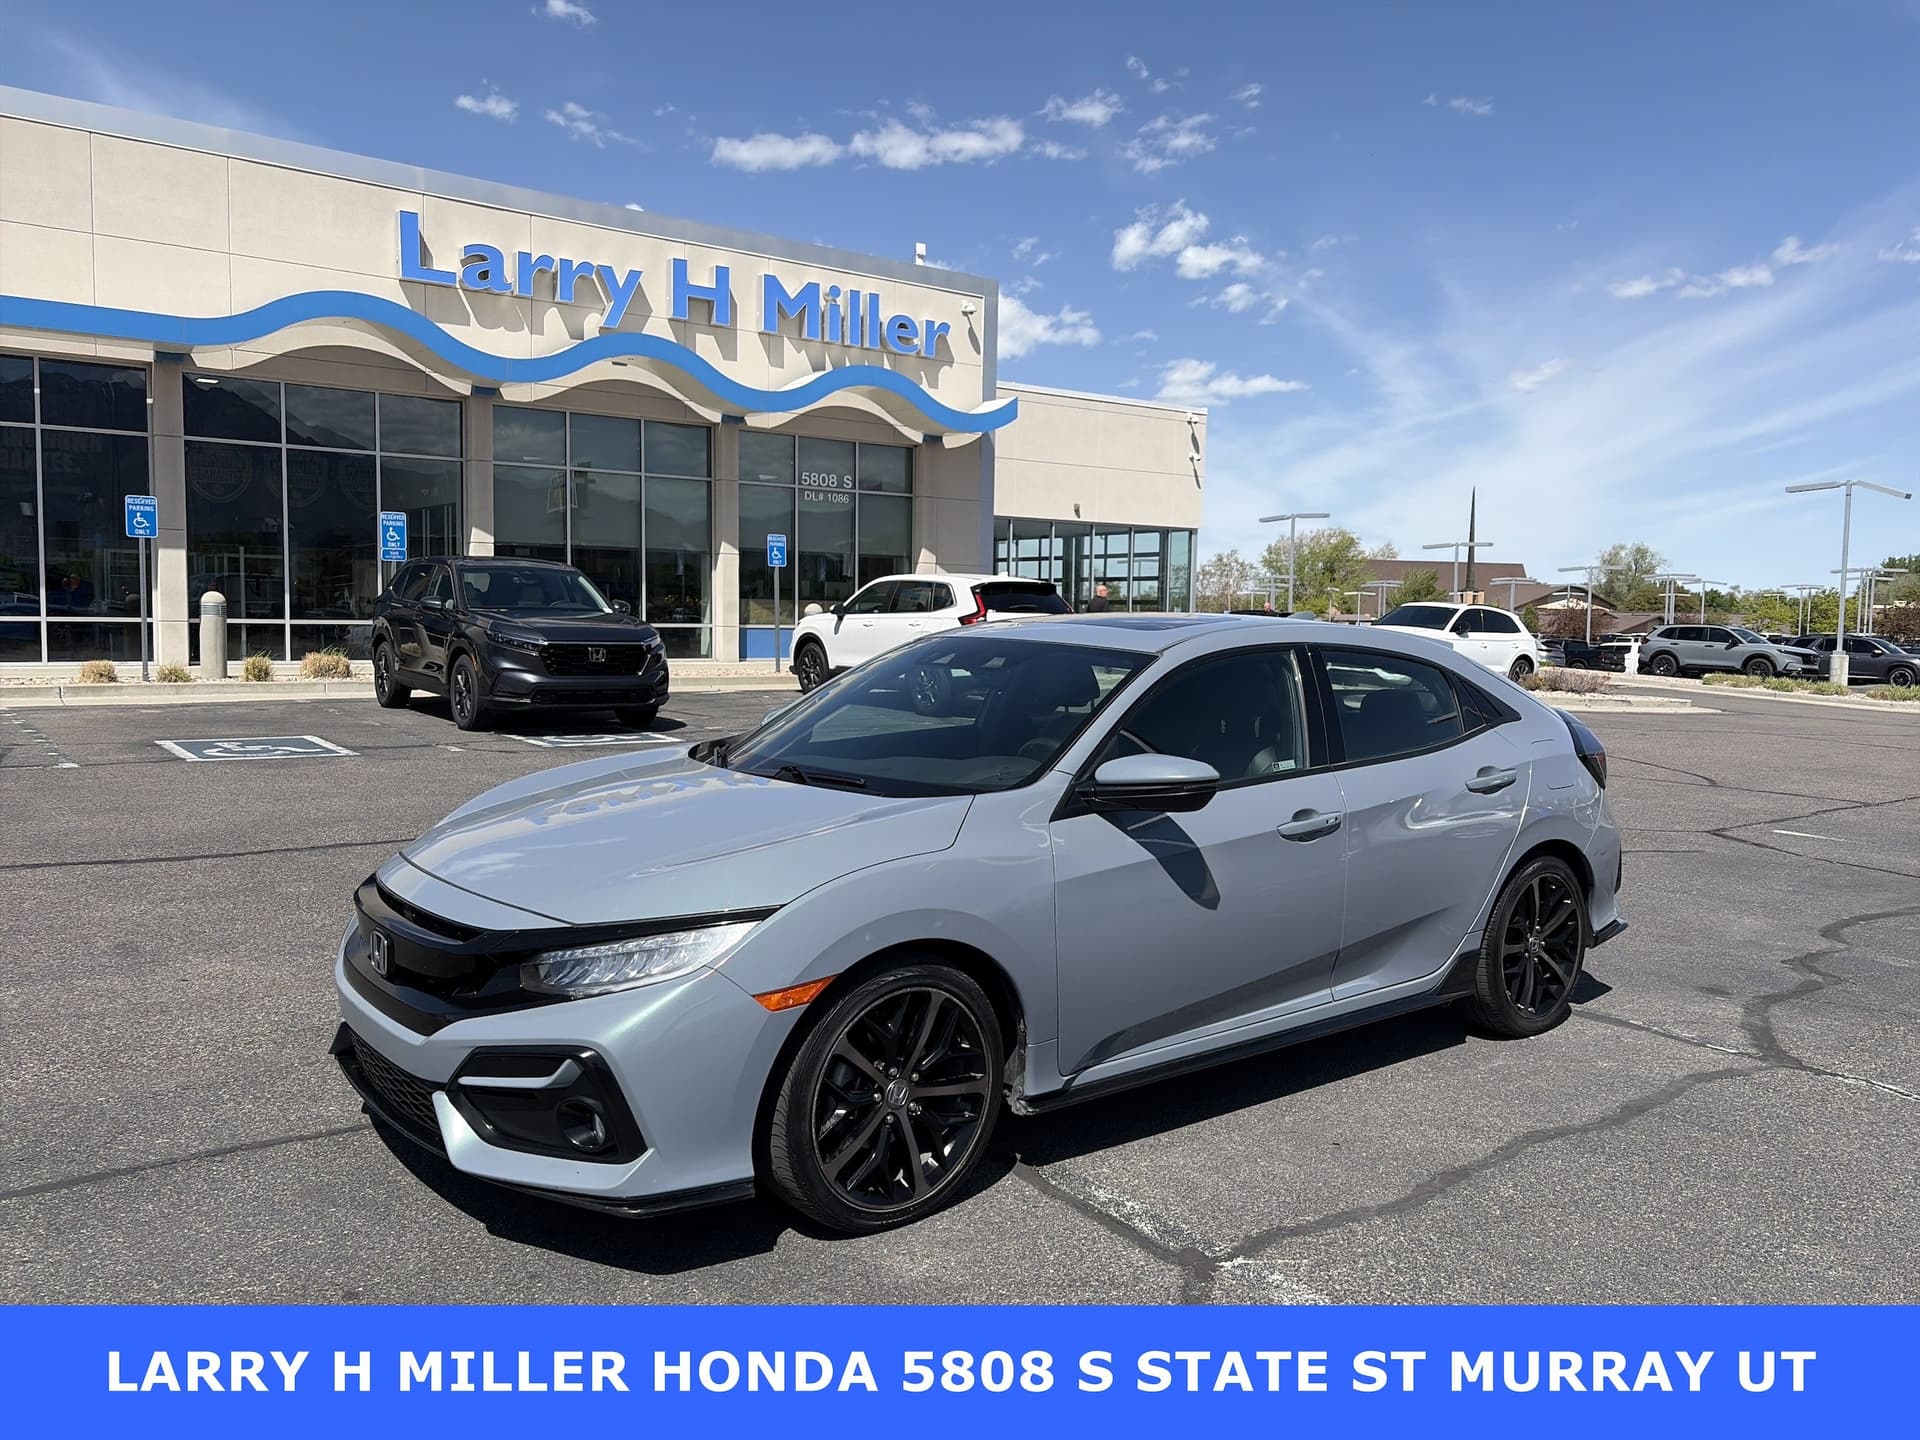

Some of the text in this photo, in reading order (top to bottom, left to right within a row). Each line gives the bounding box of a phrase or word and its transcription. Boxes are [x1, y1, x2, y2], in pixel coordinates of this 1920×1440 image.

[398, 209, 952, 358] Larry H Miller
[801, 471, 853, 489] 5808 S
[804, 490, 850, 504] DL# 1086
